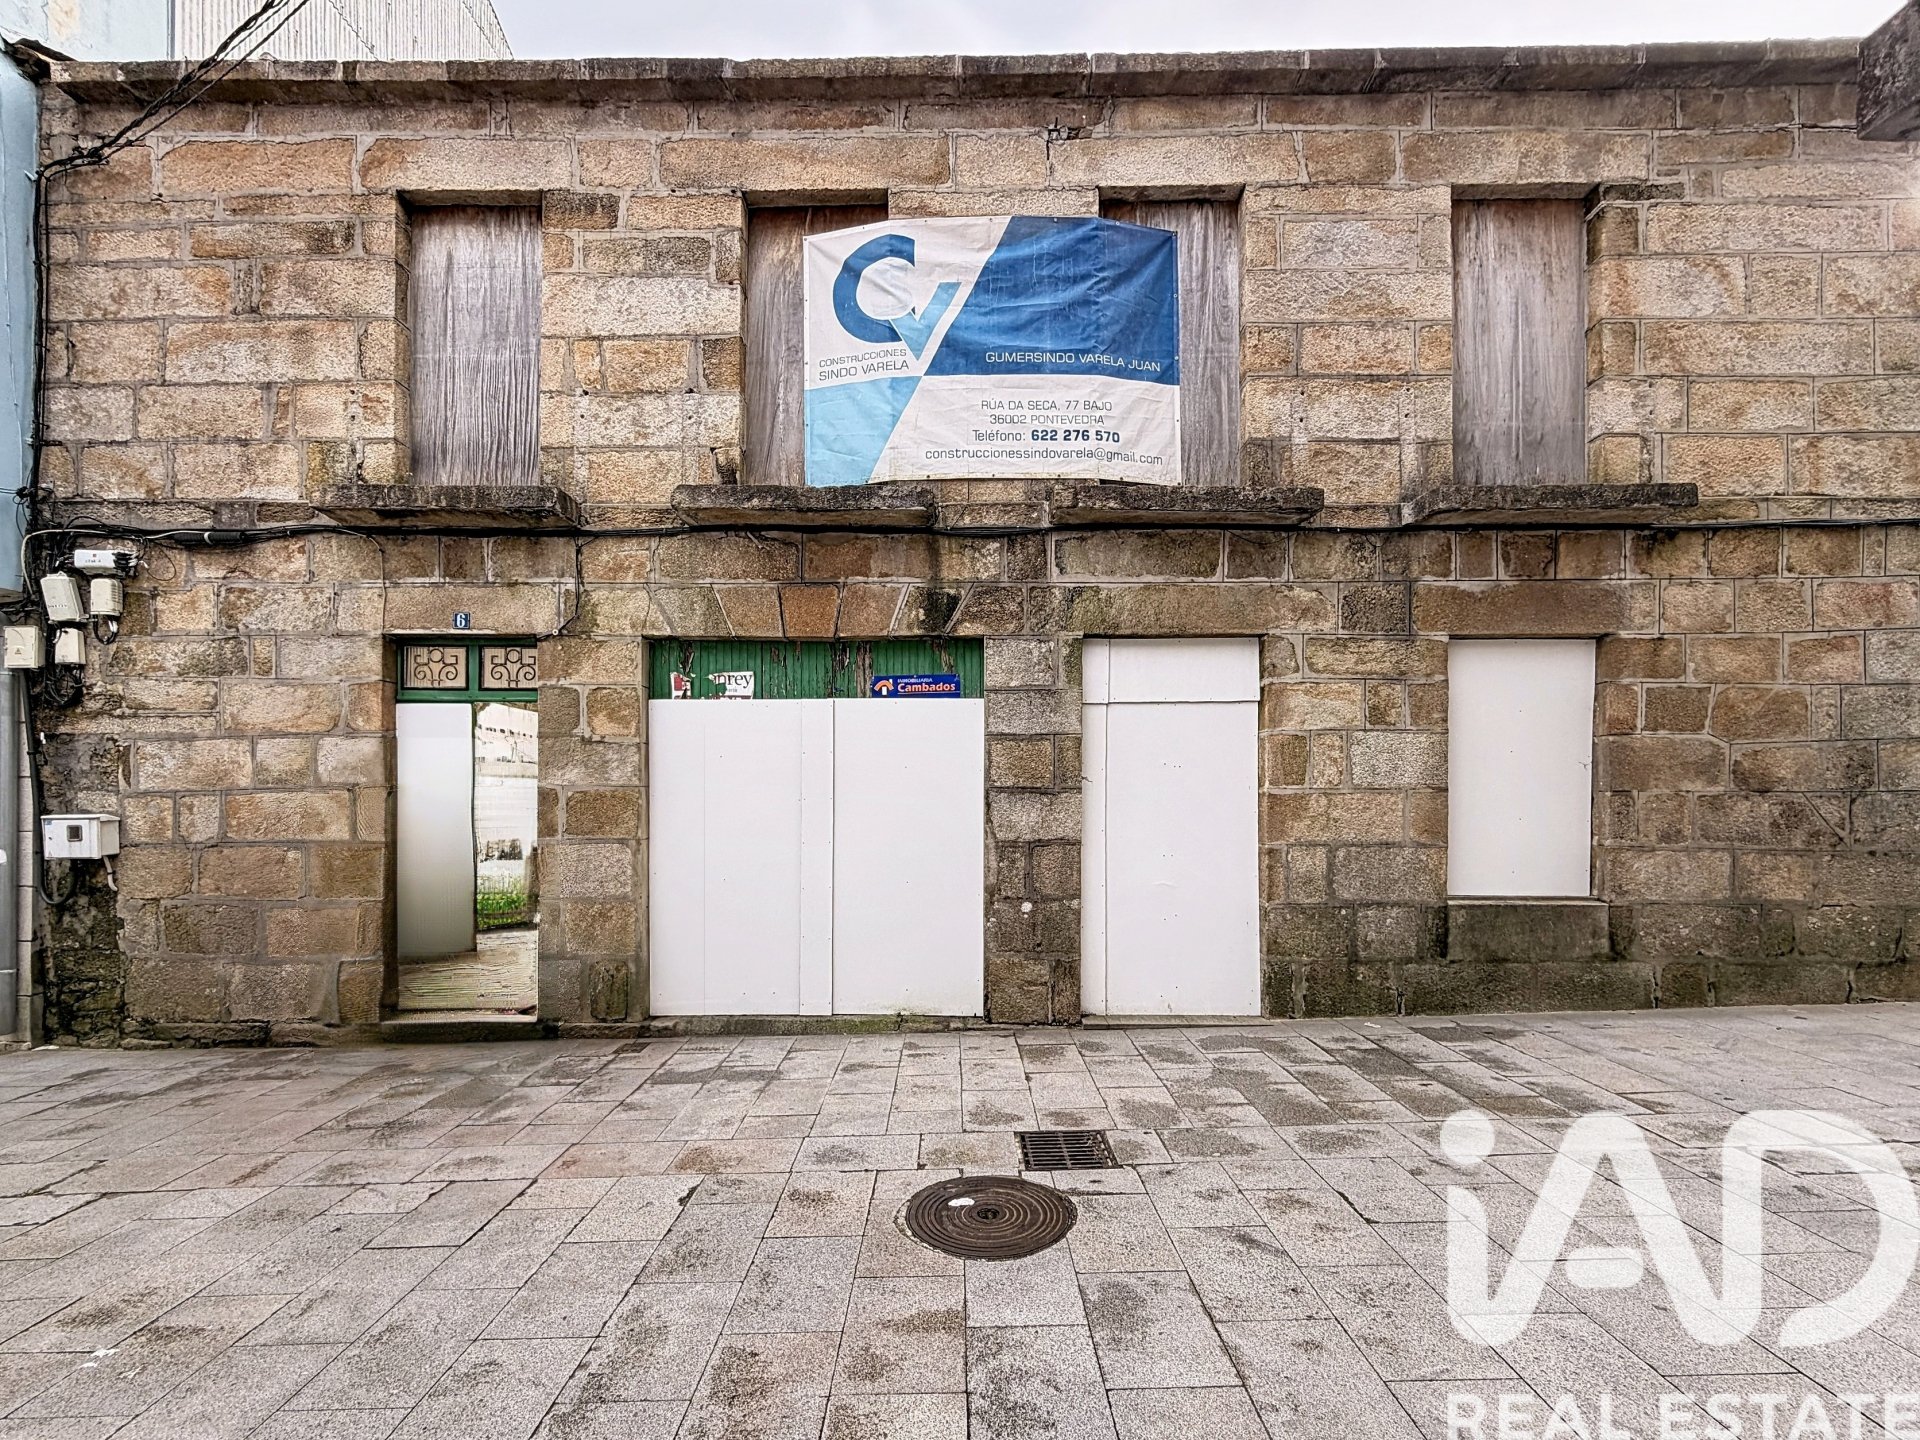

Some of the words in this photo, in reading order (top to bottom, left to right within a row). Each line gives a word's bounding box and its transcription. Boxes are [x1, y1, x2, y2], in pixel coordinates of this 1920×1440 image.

[819, 349, 907, 368] CONSTRUCCIONES
[985, 352, 1075, 363] GUMERSINDO
[1078, 353, 1125, 367] VARELA
[1128, 359, 1161, 372] JUAN
[819, 367, 858, 381] SINDO
[861, 360, 909, 374] VARELA
[981, 398, 1005, 410] RÚA
[1008, 400, 1024, 410] DA
[1027, 400, 1061, 411] SECA,
[1065, 400, 1080, 410] 77
[1083, 400, 1112, 411] BAJO
[989, 414, 1027, 425] 36002
[1030, 415, 1105, 425] PONTEVEDRA
[972, 429, 1026, 442] Teléfono:
[1031, 430, 1058, 441] 622
[1063, 430, 1090, 441] 276
[1095, 430, 1120, 443] 570
[925, 447, 1163, 465] construccionessindovarela@gmail.com
[456, 613, 466, 628] 6
[897, 682, 956, 693] Cambados
